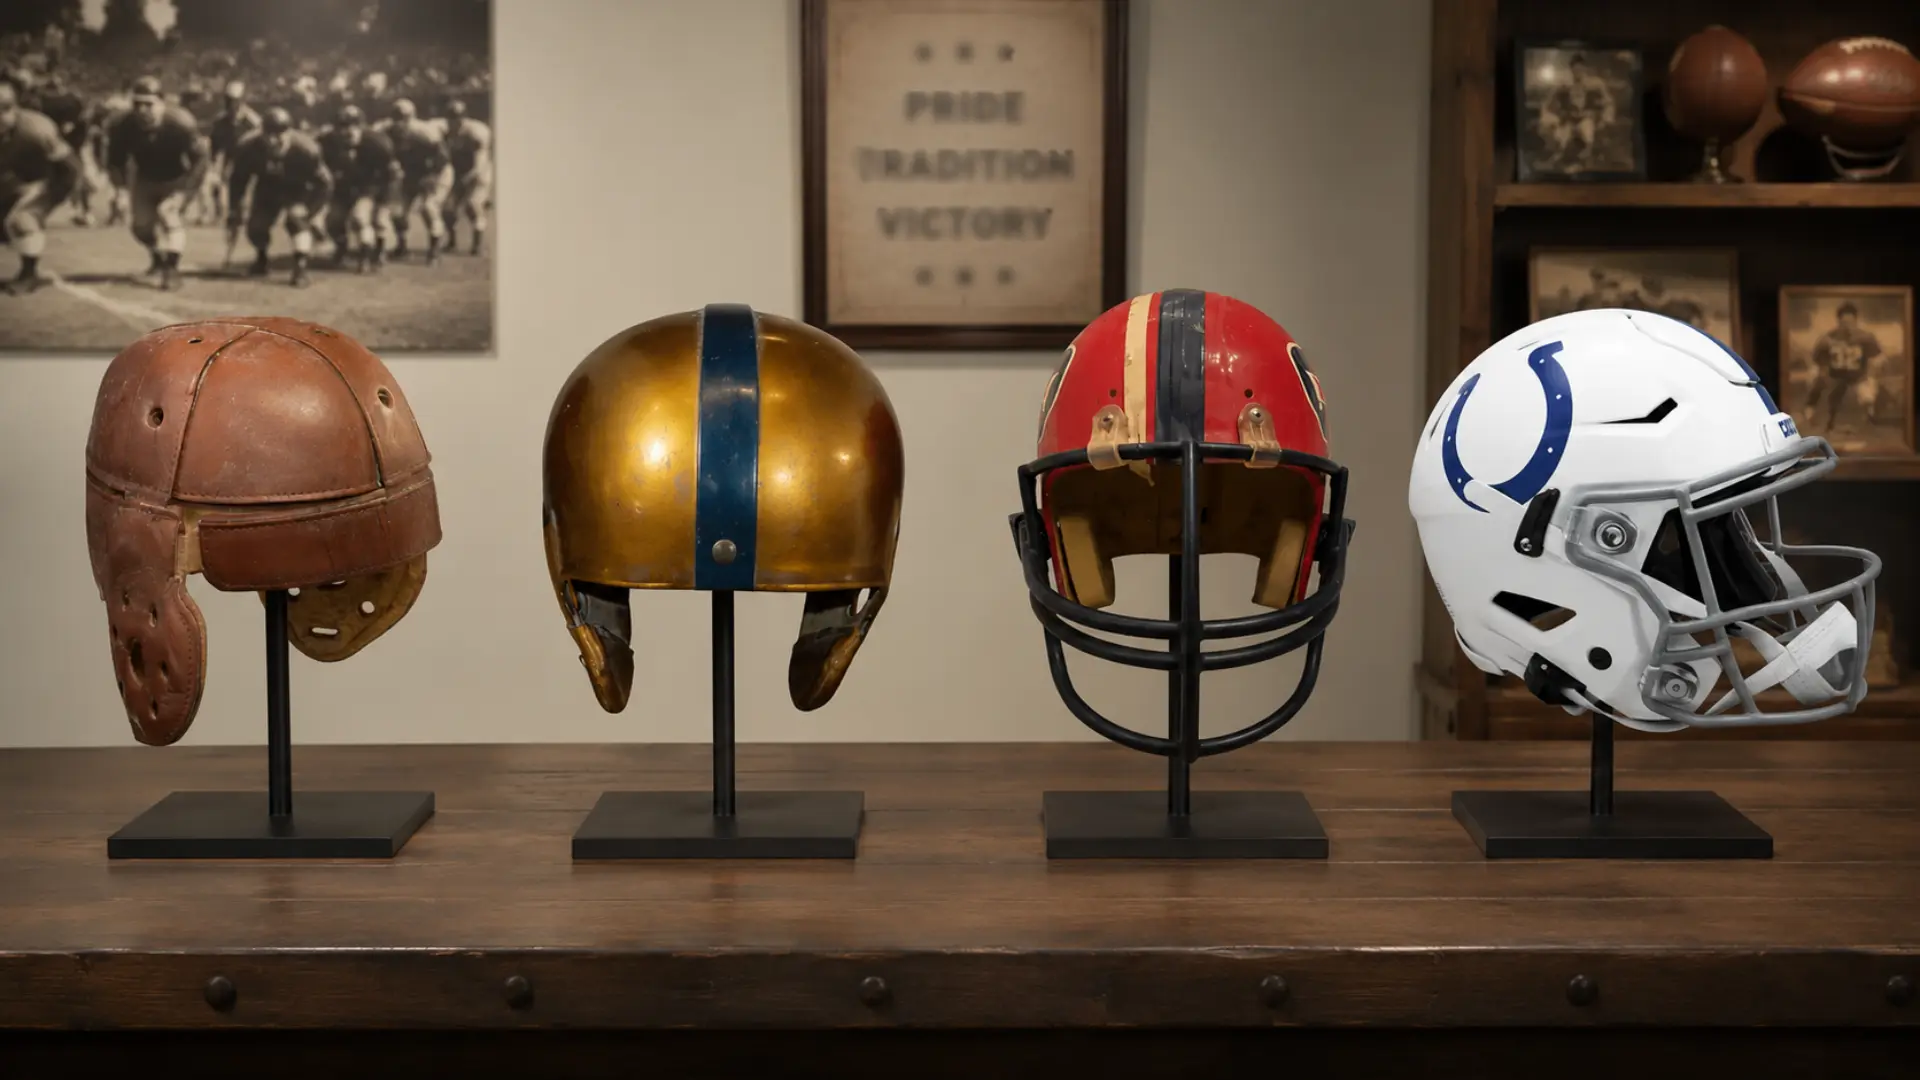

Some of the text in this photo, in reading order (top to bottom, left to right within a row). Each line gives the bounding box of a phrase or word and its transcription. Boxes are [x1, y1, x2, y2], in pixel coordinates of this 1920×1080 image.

[905, 91, 1023, 124] PRIDE
[857, 148, 1074, 181] TRADITION
[877, 207, 1052, 240] VICTORY
